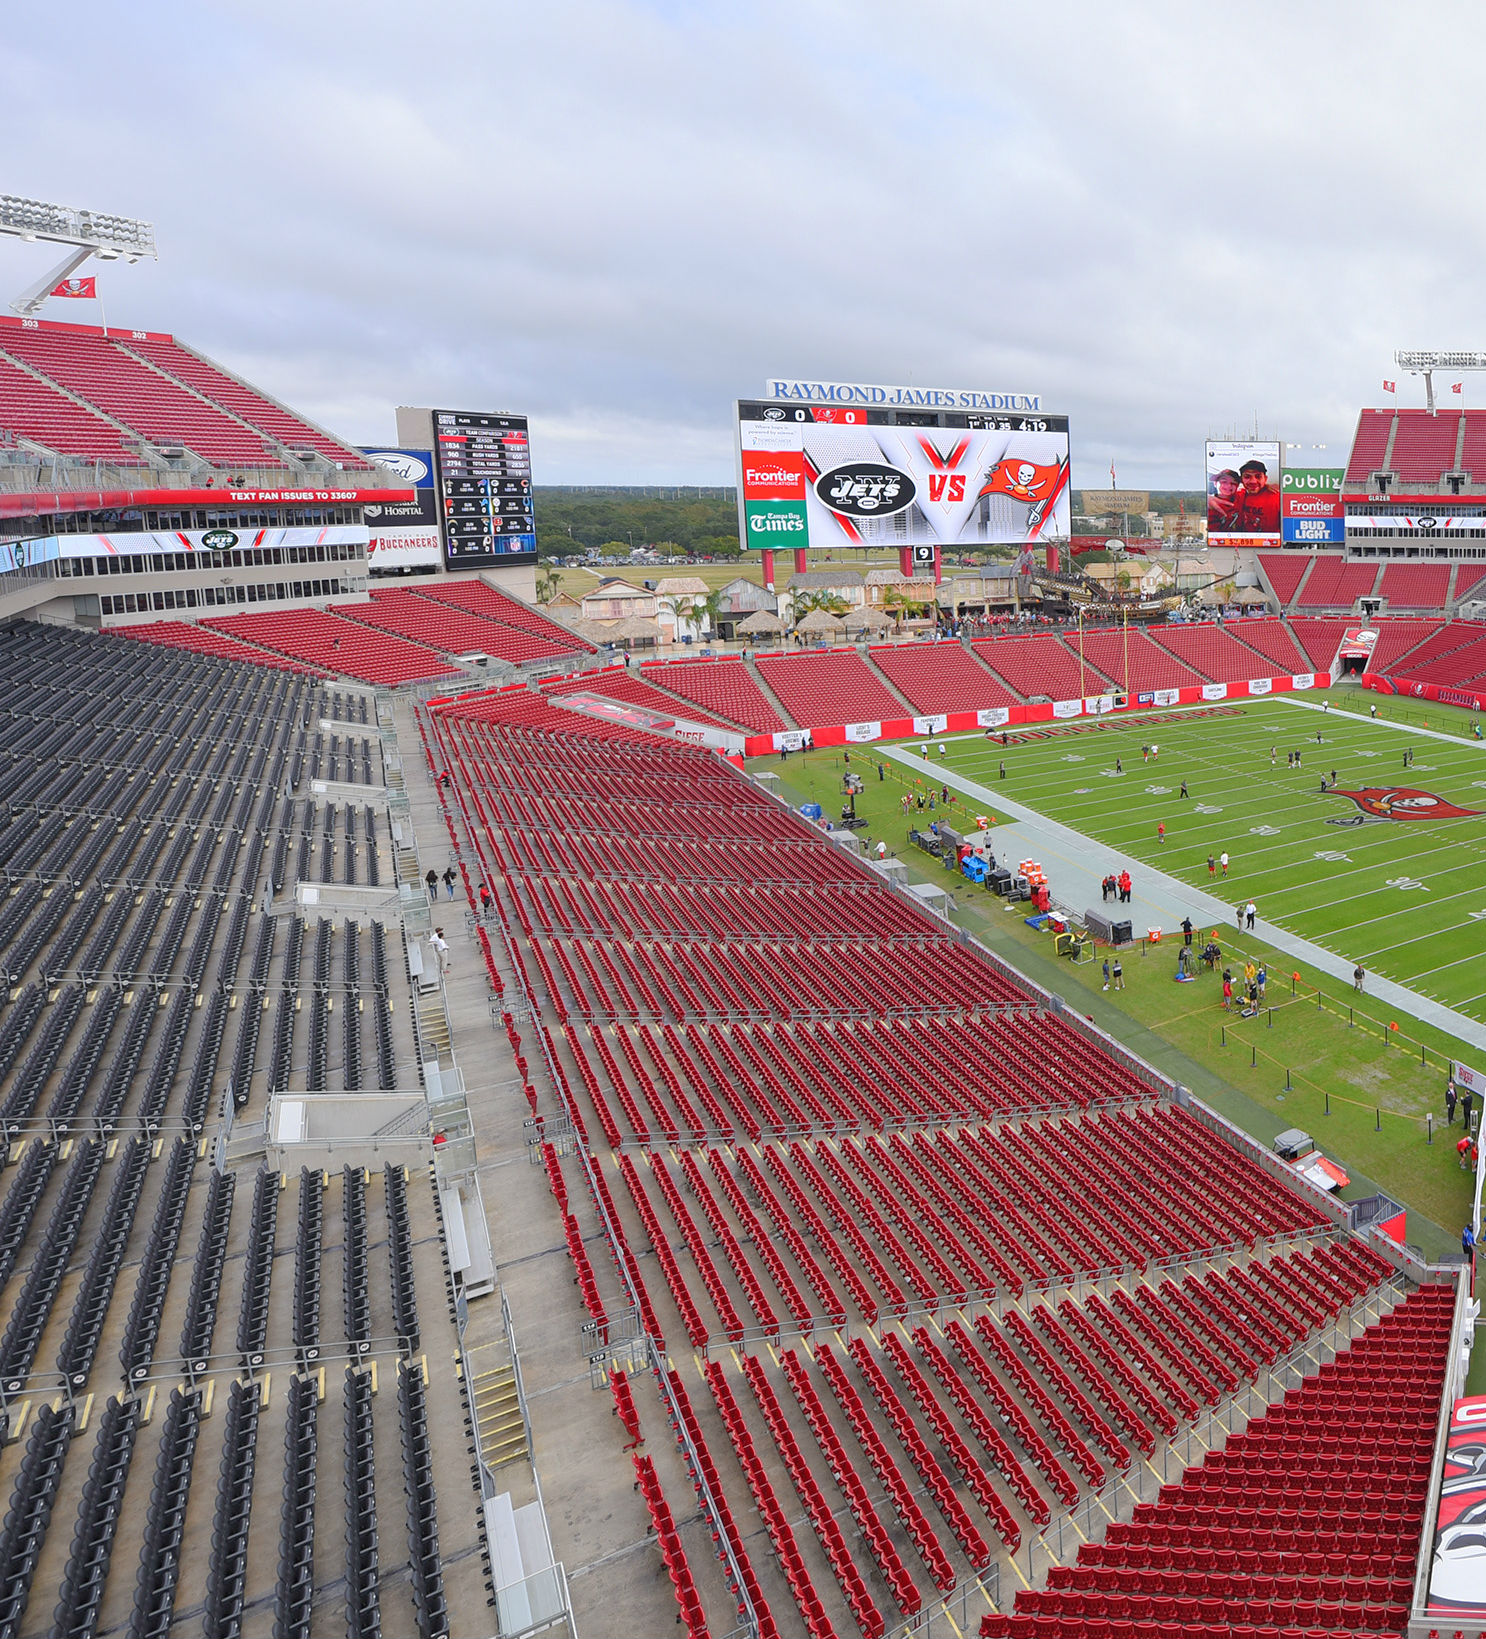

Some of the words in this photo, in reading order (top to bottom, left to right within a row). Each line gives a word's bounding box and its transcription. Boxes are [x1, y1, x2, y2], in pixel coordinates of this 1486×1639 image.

[21, 319, 38, 328] 303
[132, 331, 147, 339] 302
[773, 381, 886, 402] RAYMOND
[890, 388, 955, 407] JAMES
[959, 393, 1040, 411] STADIUM
[795, 409, 805, 421] 0
[845, 411, 855, 423] 0
[984, 422, 996, 430] 10
[999, 423, 1011, 431] 35
[1018, 422, 1047, 432] 4:19
[746, 469, 801, 482] Frontier
[929, 474, 966, 502] VS
[1282, 474, 1342, 490] Publix
[830, 481, 901, 498] JETS
[230, 492, 256, 501] TEXT
[258, 492, 278, 501] FAN
[281, 491, 312, 501] ISSUES
[315, 491, 329, 500] TO
[331, 491, 357, 500] 33607
[384, 506, 424, 516] HOSPITAL
[1290, 500, 1336, 512] Frontier
[767, 512, 788, 520] Tampa
[750, 514, 804, 532] Times
[1300, 521, 1326, 531] BUD
[1295, 530, 1331, 540] LIGHT
[379, 536, 438, 552] BUCCANEERS
[919, 547, 929, 560] 9
[1385, 877, 1422, 891] 30
